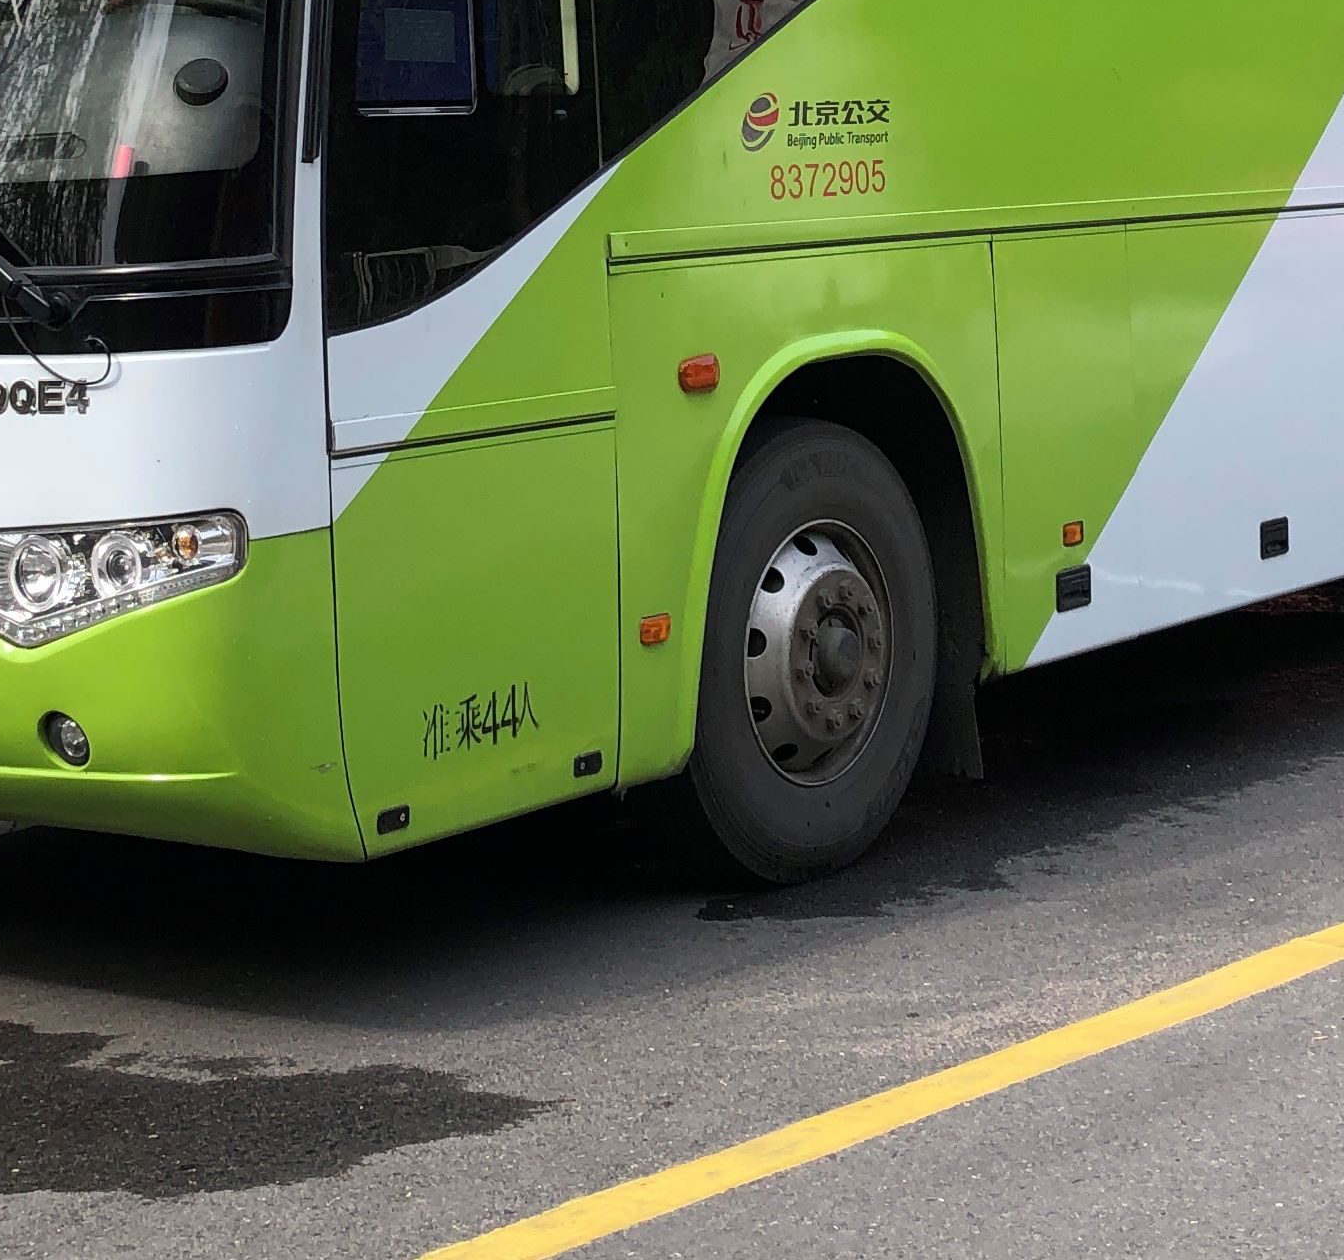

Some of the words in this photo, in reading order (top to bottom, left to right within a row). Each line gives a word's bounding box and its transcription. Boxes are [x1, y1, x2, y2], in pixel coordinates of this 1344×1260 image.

[787, 98, 891, 127] 北京公交
[787, 133, 817, 150] Beijing
[819, 132, 845, 146] Public
[847, 130, 889, 147] Transport
[770, 159, 887, 200] 8372905
